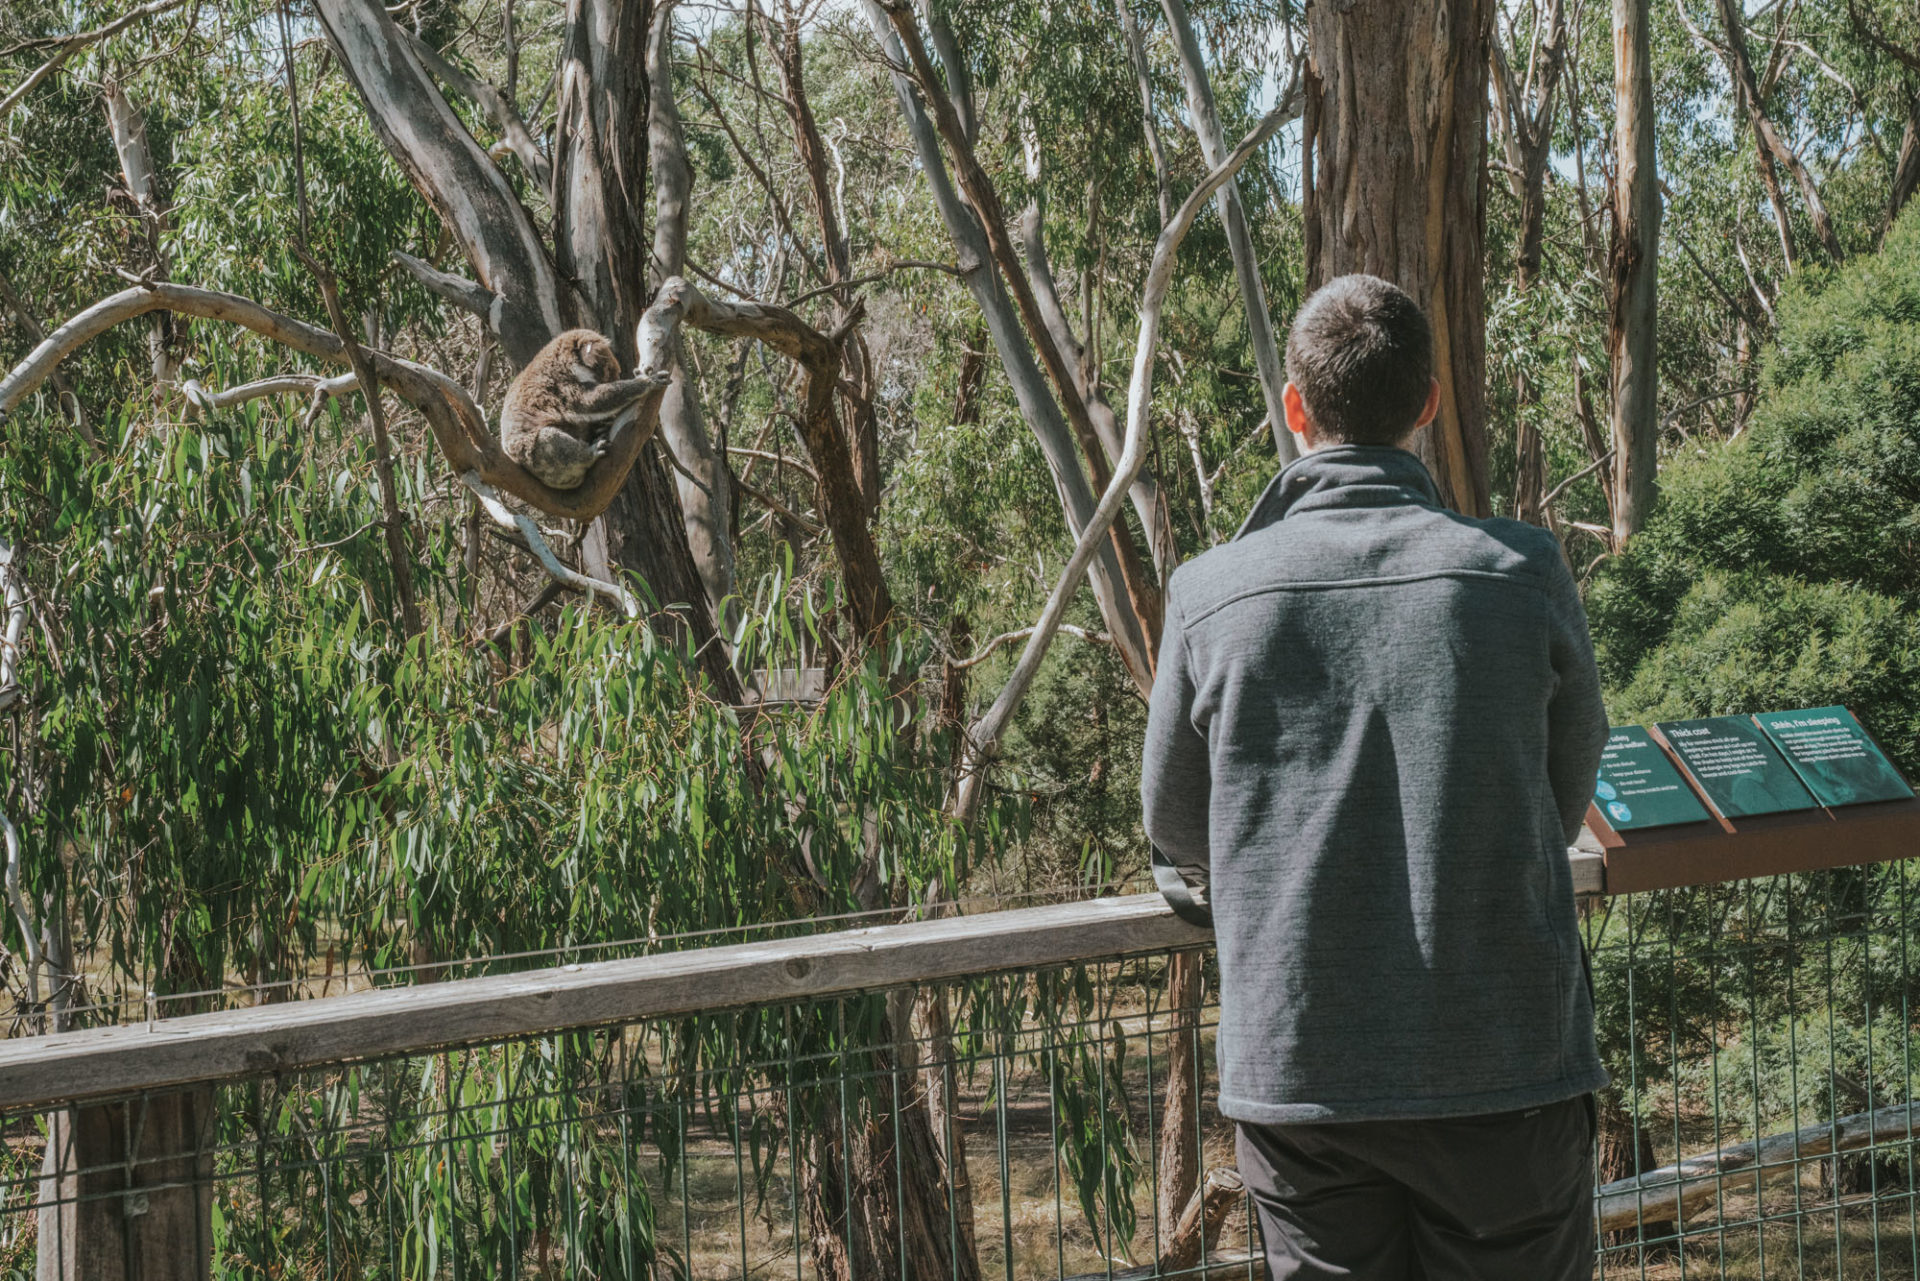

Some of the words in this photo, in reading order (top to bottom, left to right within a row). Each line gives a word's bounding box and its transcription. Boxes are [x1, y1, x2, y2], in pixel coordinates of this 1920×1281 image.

[1807, 718, 1841, 727] sleeping
[1669, 729, 1693, 737] Thick
[1693, 728, 1711, 736] coat
